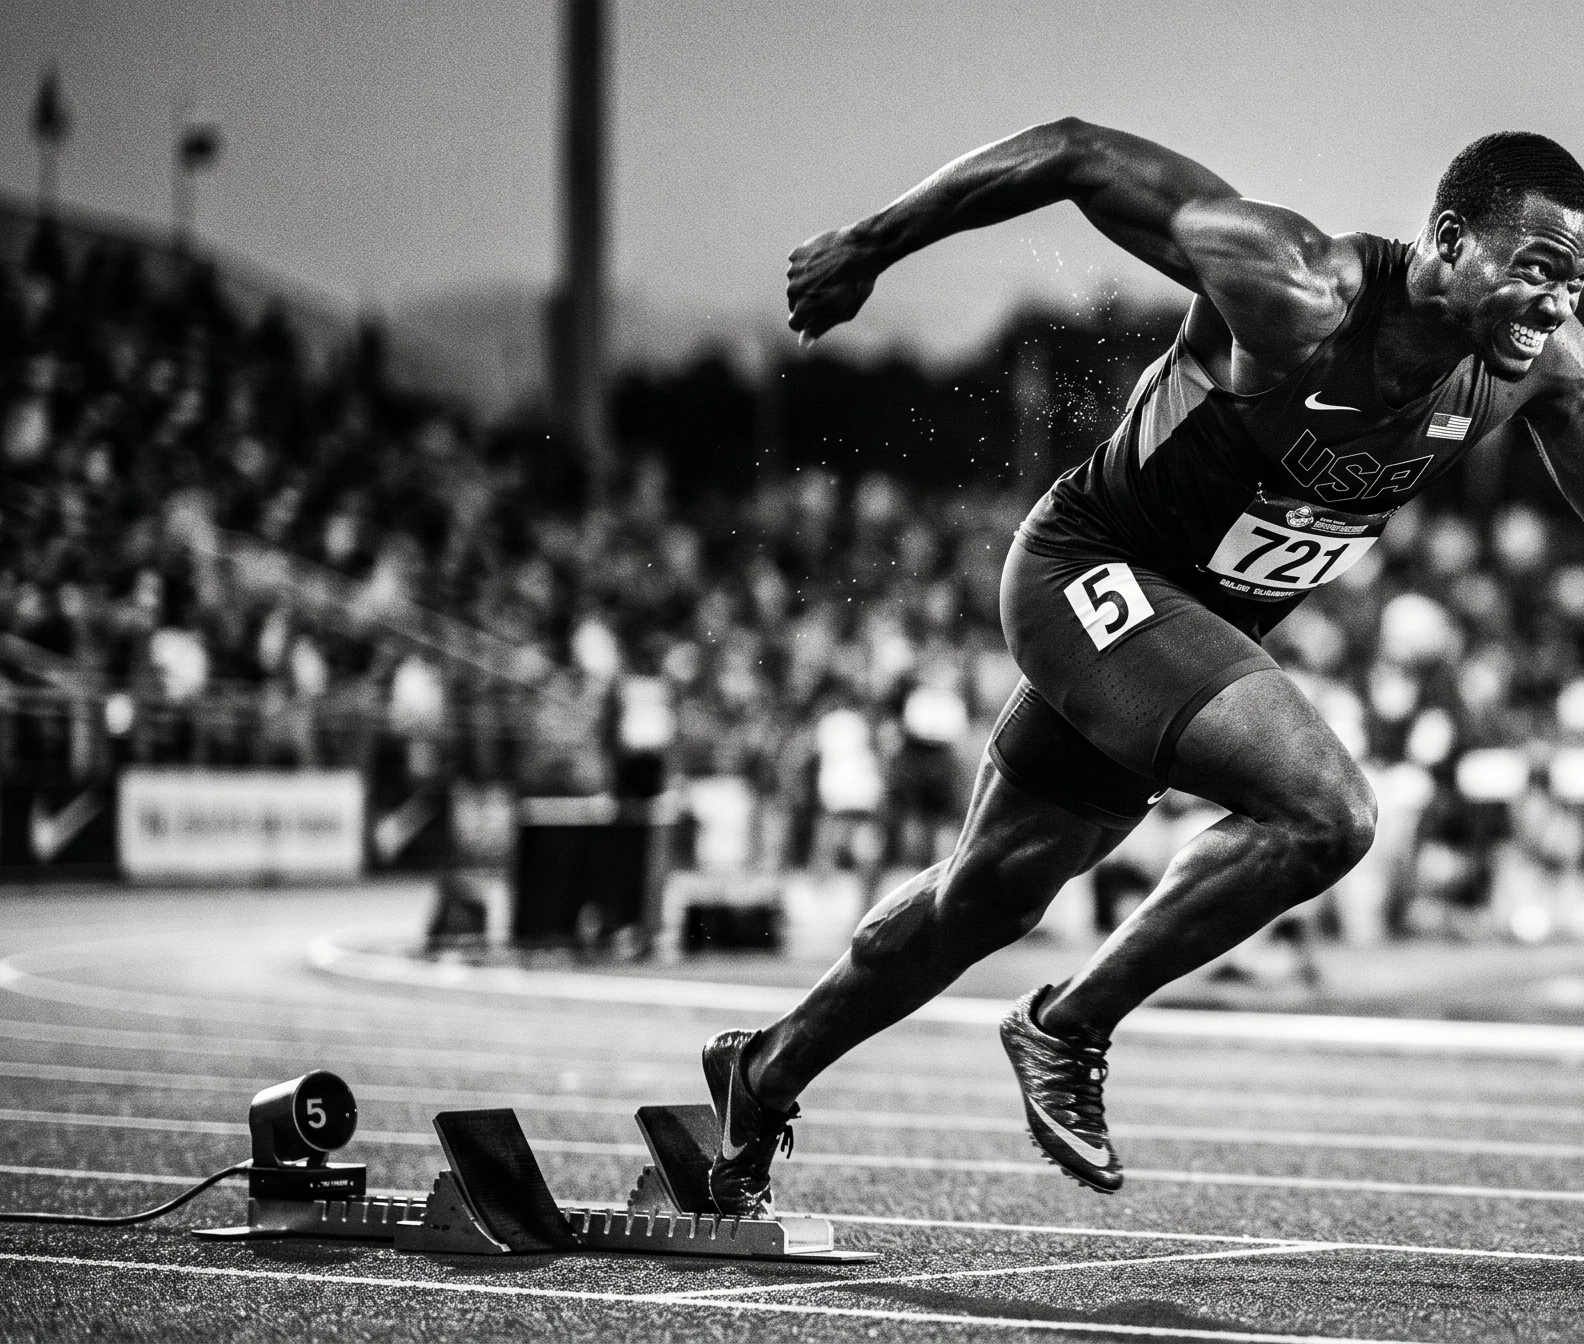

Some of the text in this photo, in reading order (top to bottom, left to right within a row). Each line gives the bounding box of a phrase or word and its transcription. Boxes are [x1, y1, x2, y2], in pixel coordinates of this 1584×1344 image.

[1281, 428, 1435, 503] USA
[1232, 526, 1351, 585] 721
[1081, 567, 1130, 635] 5
[306, 1098, 327, 1129] 5
